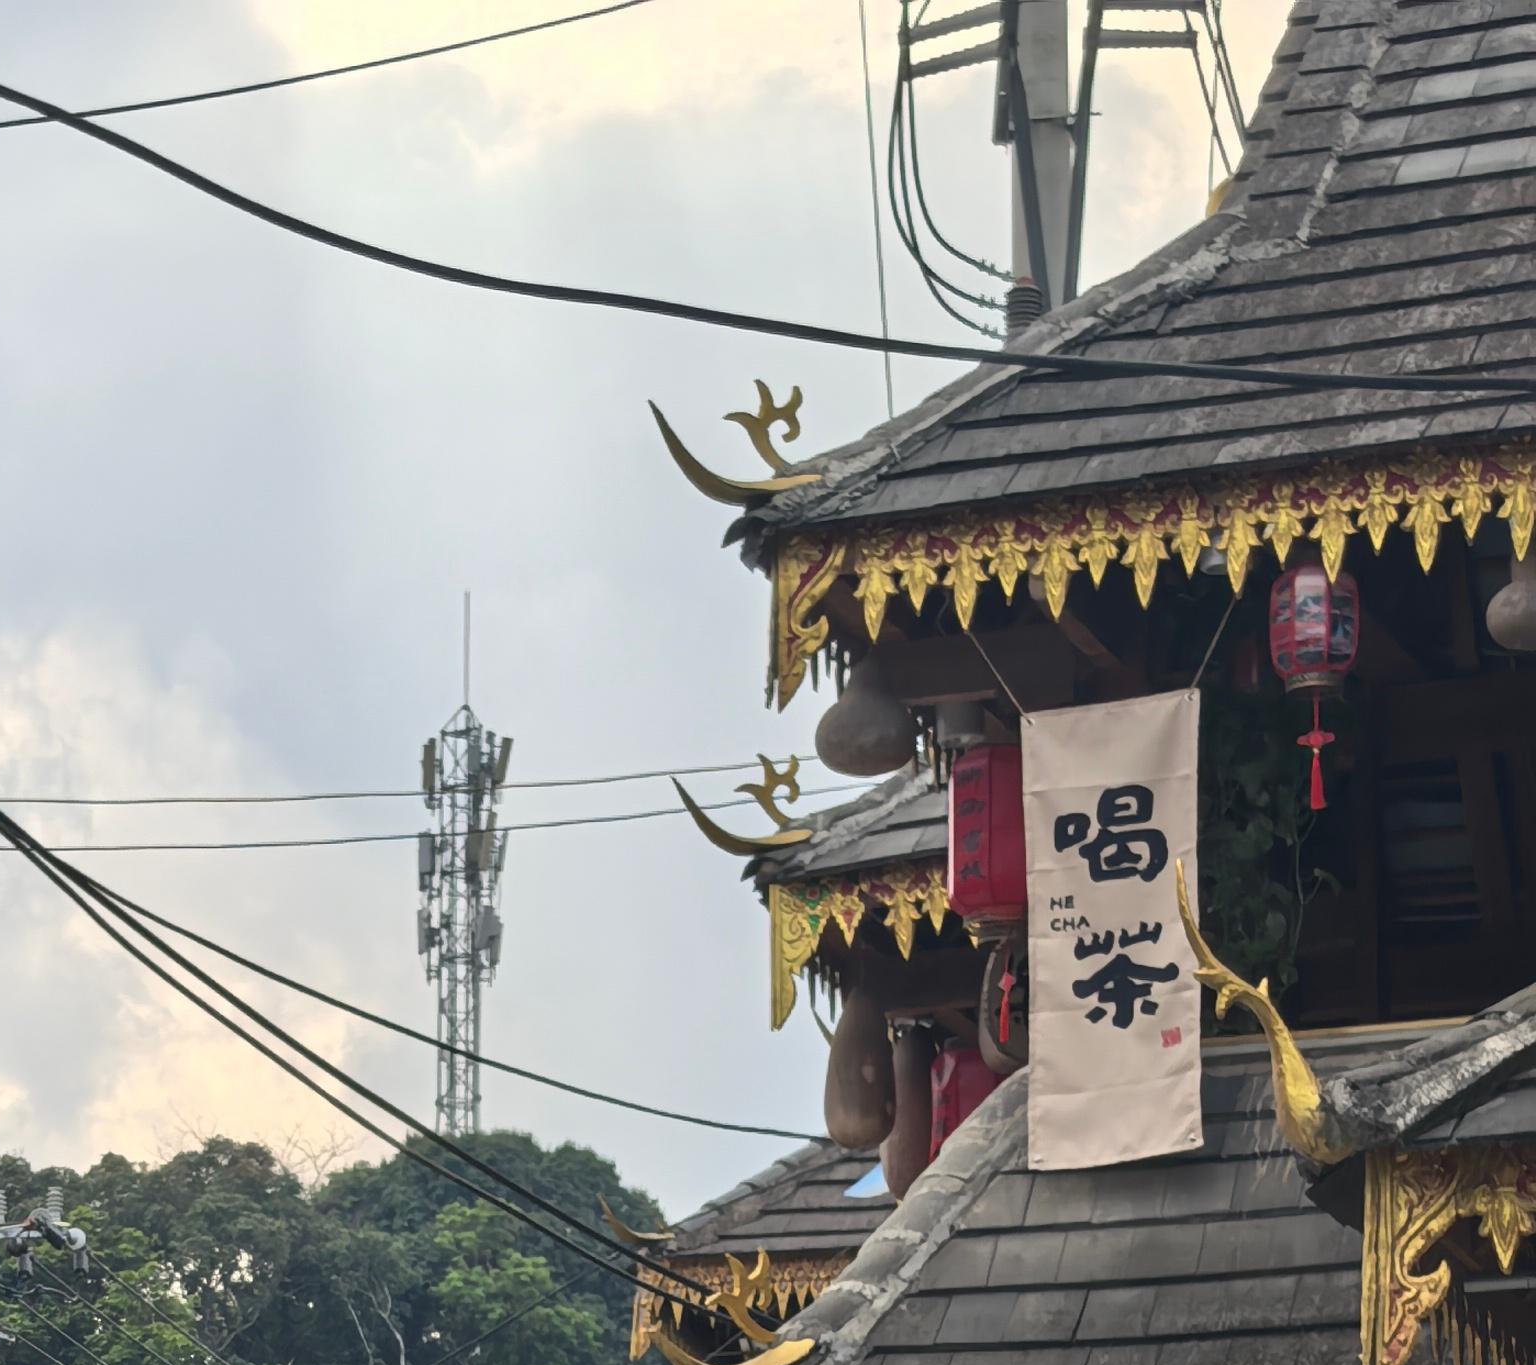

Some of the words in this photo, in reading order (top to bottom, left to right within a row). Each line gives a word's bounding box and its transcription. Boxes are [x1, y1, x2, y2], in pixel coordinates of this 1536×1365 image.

[1050, 895, 1075, 910] HE
[1054, 784, 1180, 1029] 喝茶
[1050, 916, 1090, 932] CHA
